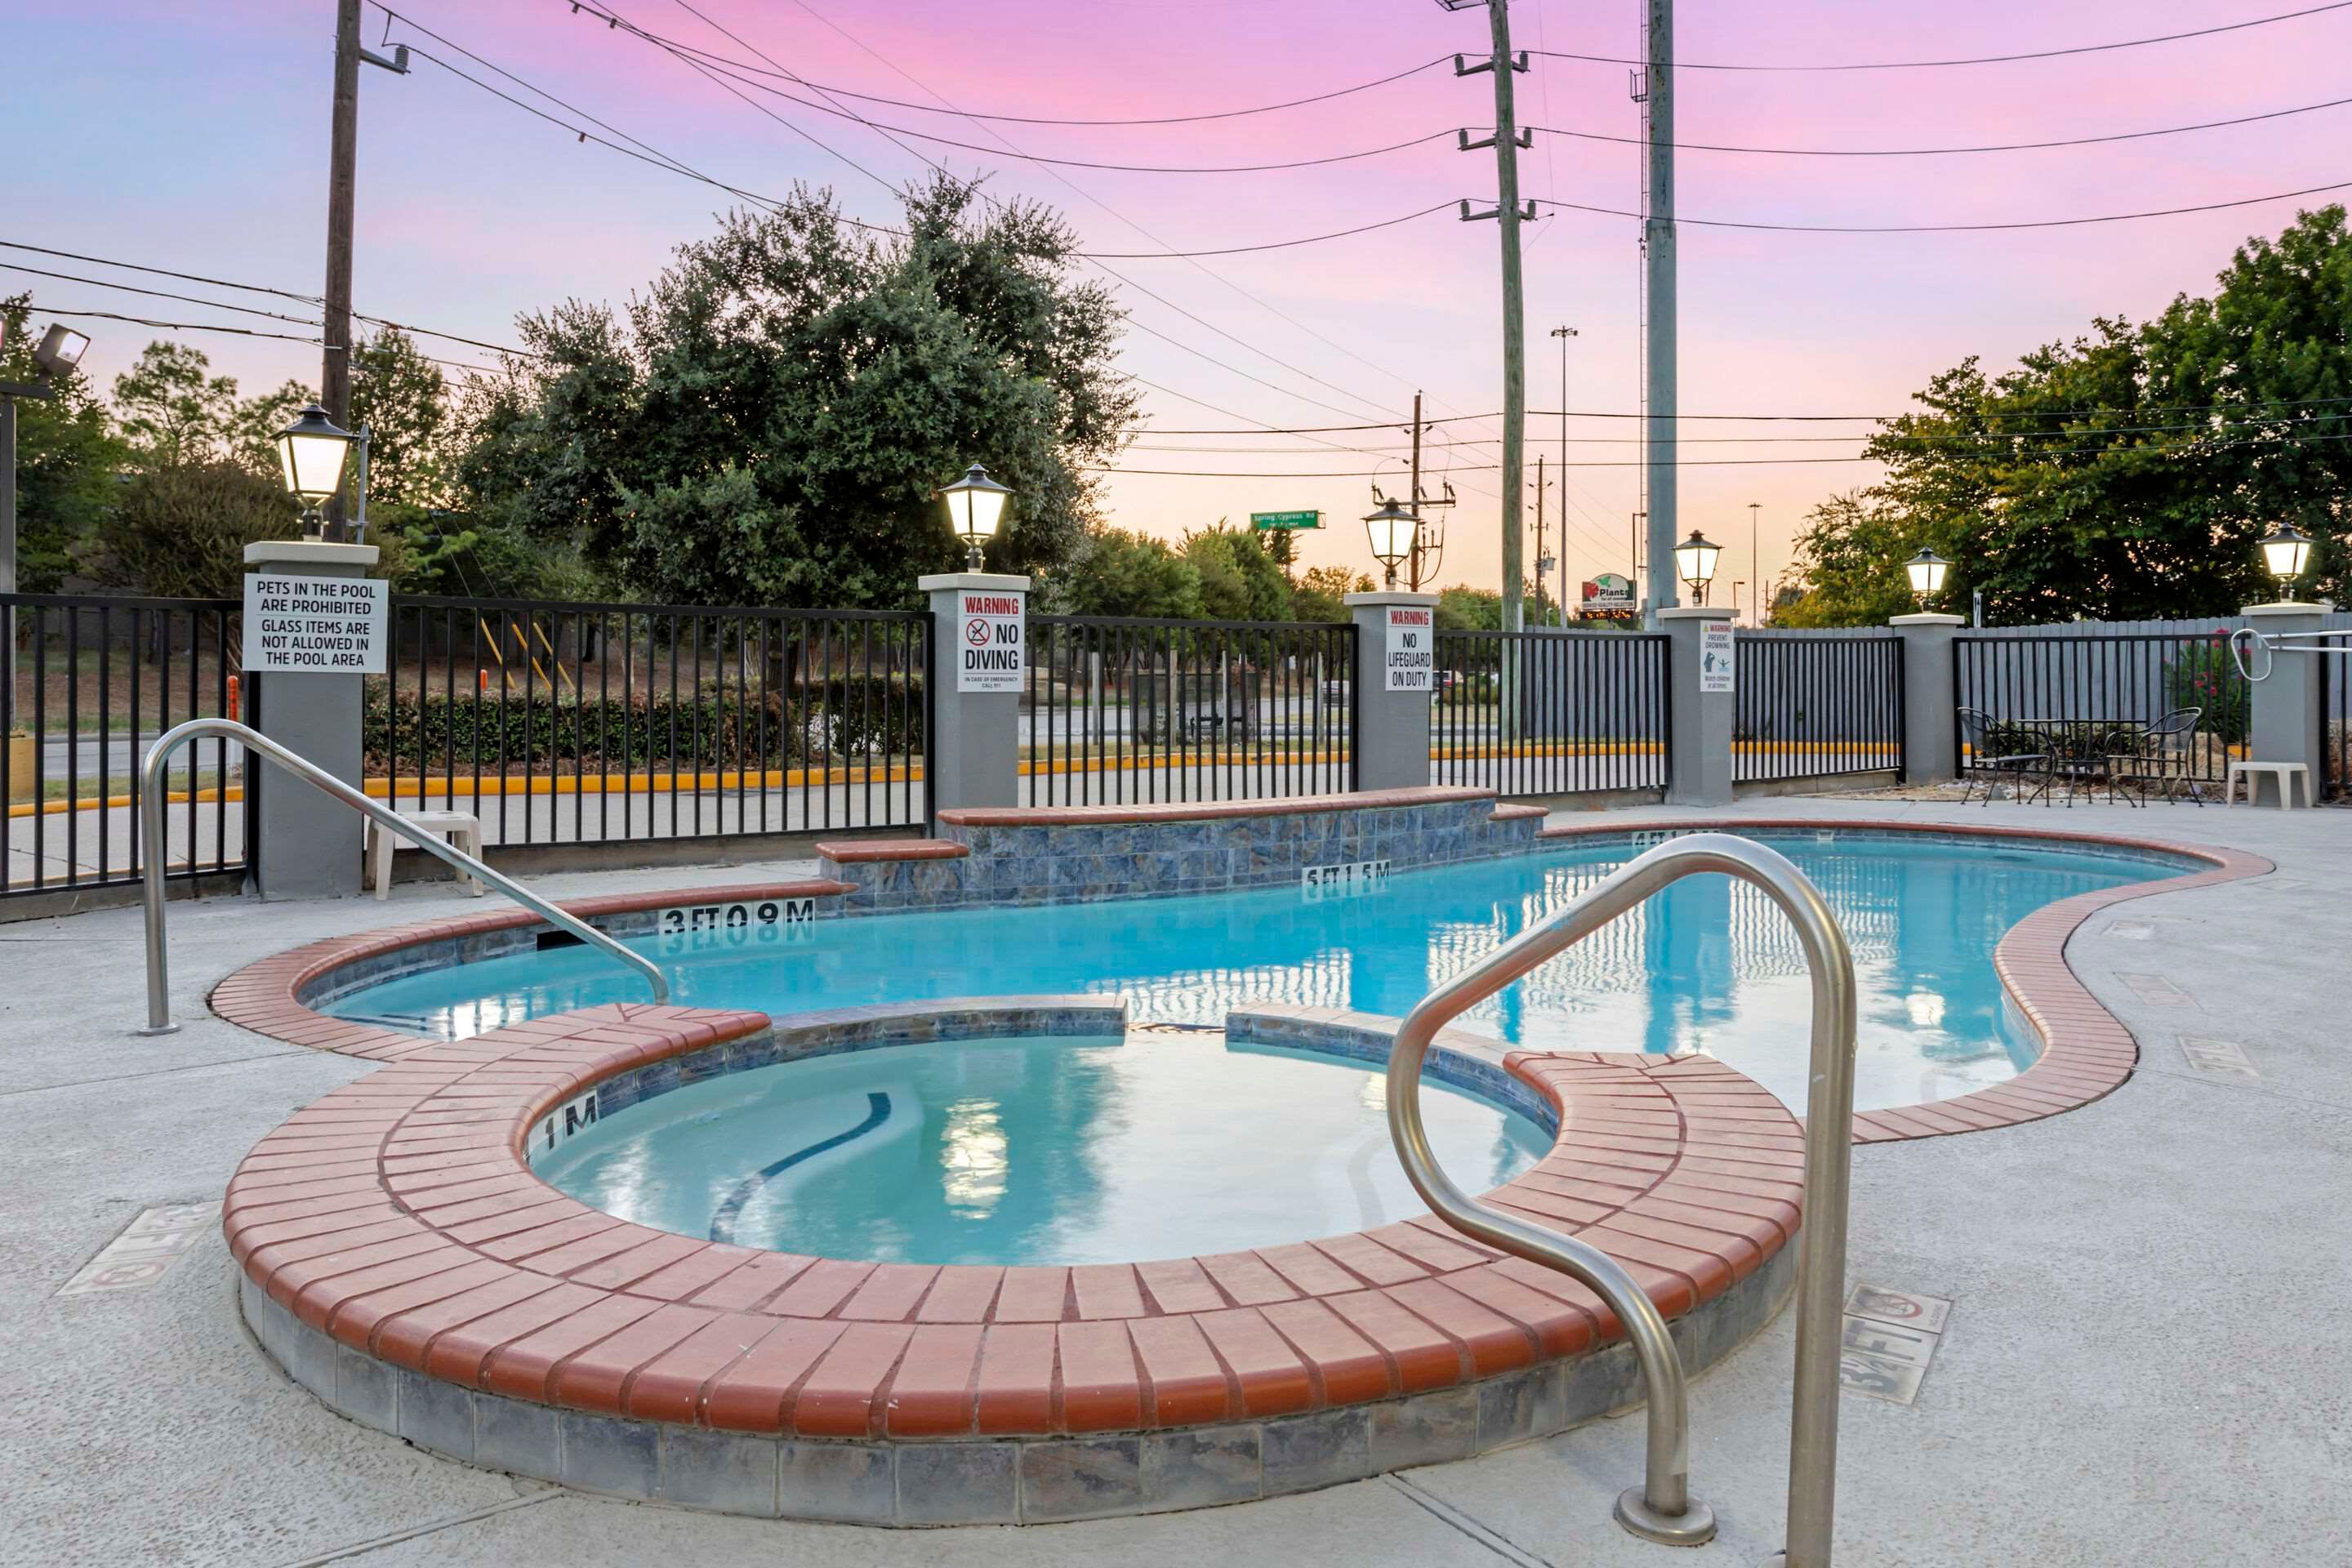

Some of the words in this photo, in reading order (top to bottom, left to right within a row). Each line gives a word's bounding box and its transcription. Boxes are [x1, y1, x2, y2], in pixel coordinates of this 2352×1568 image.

[257, 581, 289, 595] PETS
[295, 583, 307, 595] IN
[312, 584, 336, 596] THE
[341, 586, 376, 598] POOL
[261, 599, 287, 611] ARE
[292, 600, 371, 614] PROHIBITED
[965, 596, 1018, 614] WARNING
[1391, 611, 1429, 625] WARNING
[262, 619, 301, 633] GLASS
[306, 621, 341, 634] ITEMS
[346, 622, 369, 635] ARE
[996, 624, 1018, 644] NO
[262, 636, 287, 648] NOT
[292, 637, 352, 650] ALLOWED
[357, 639, 368, 650] IN
[1403, 633, 1416, 648] NO
[266, 653, 289, 665] THE
[294, 653, 327, 665] POOL
[332, 653, 364, 666] AREA
[965, 650, 1018, 670] DIVING
[1389, 653, 1430, 667] LIFEGUARD
[1392, 671, 1404, 686] ON
[1406, 671, 1427, 686] DUTY
